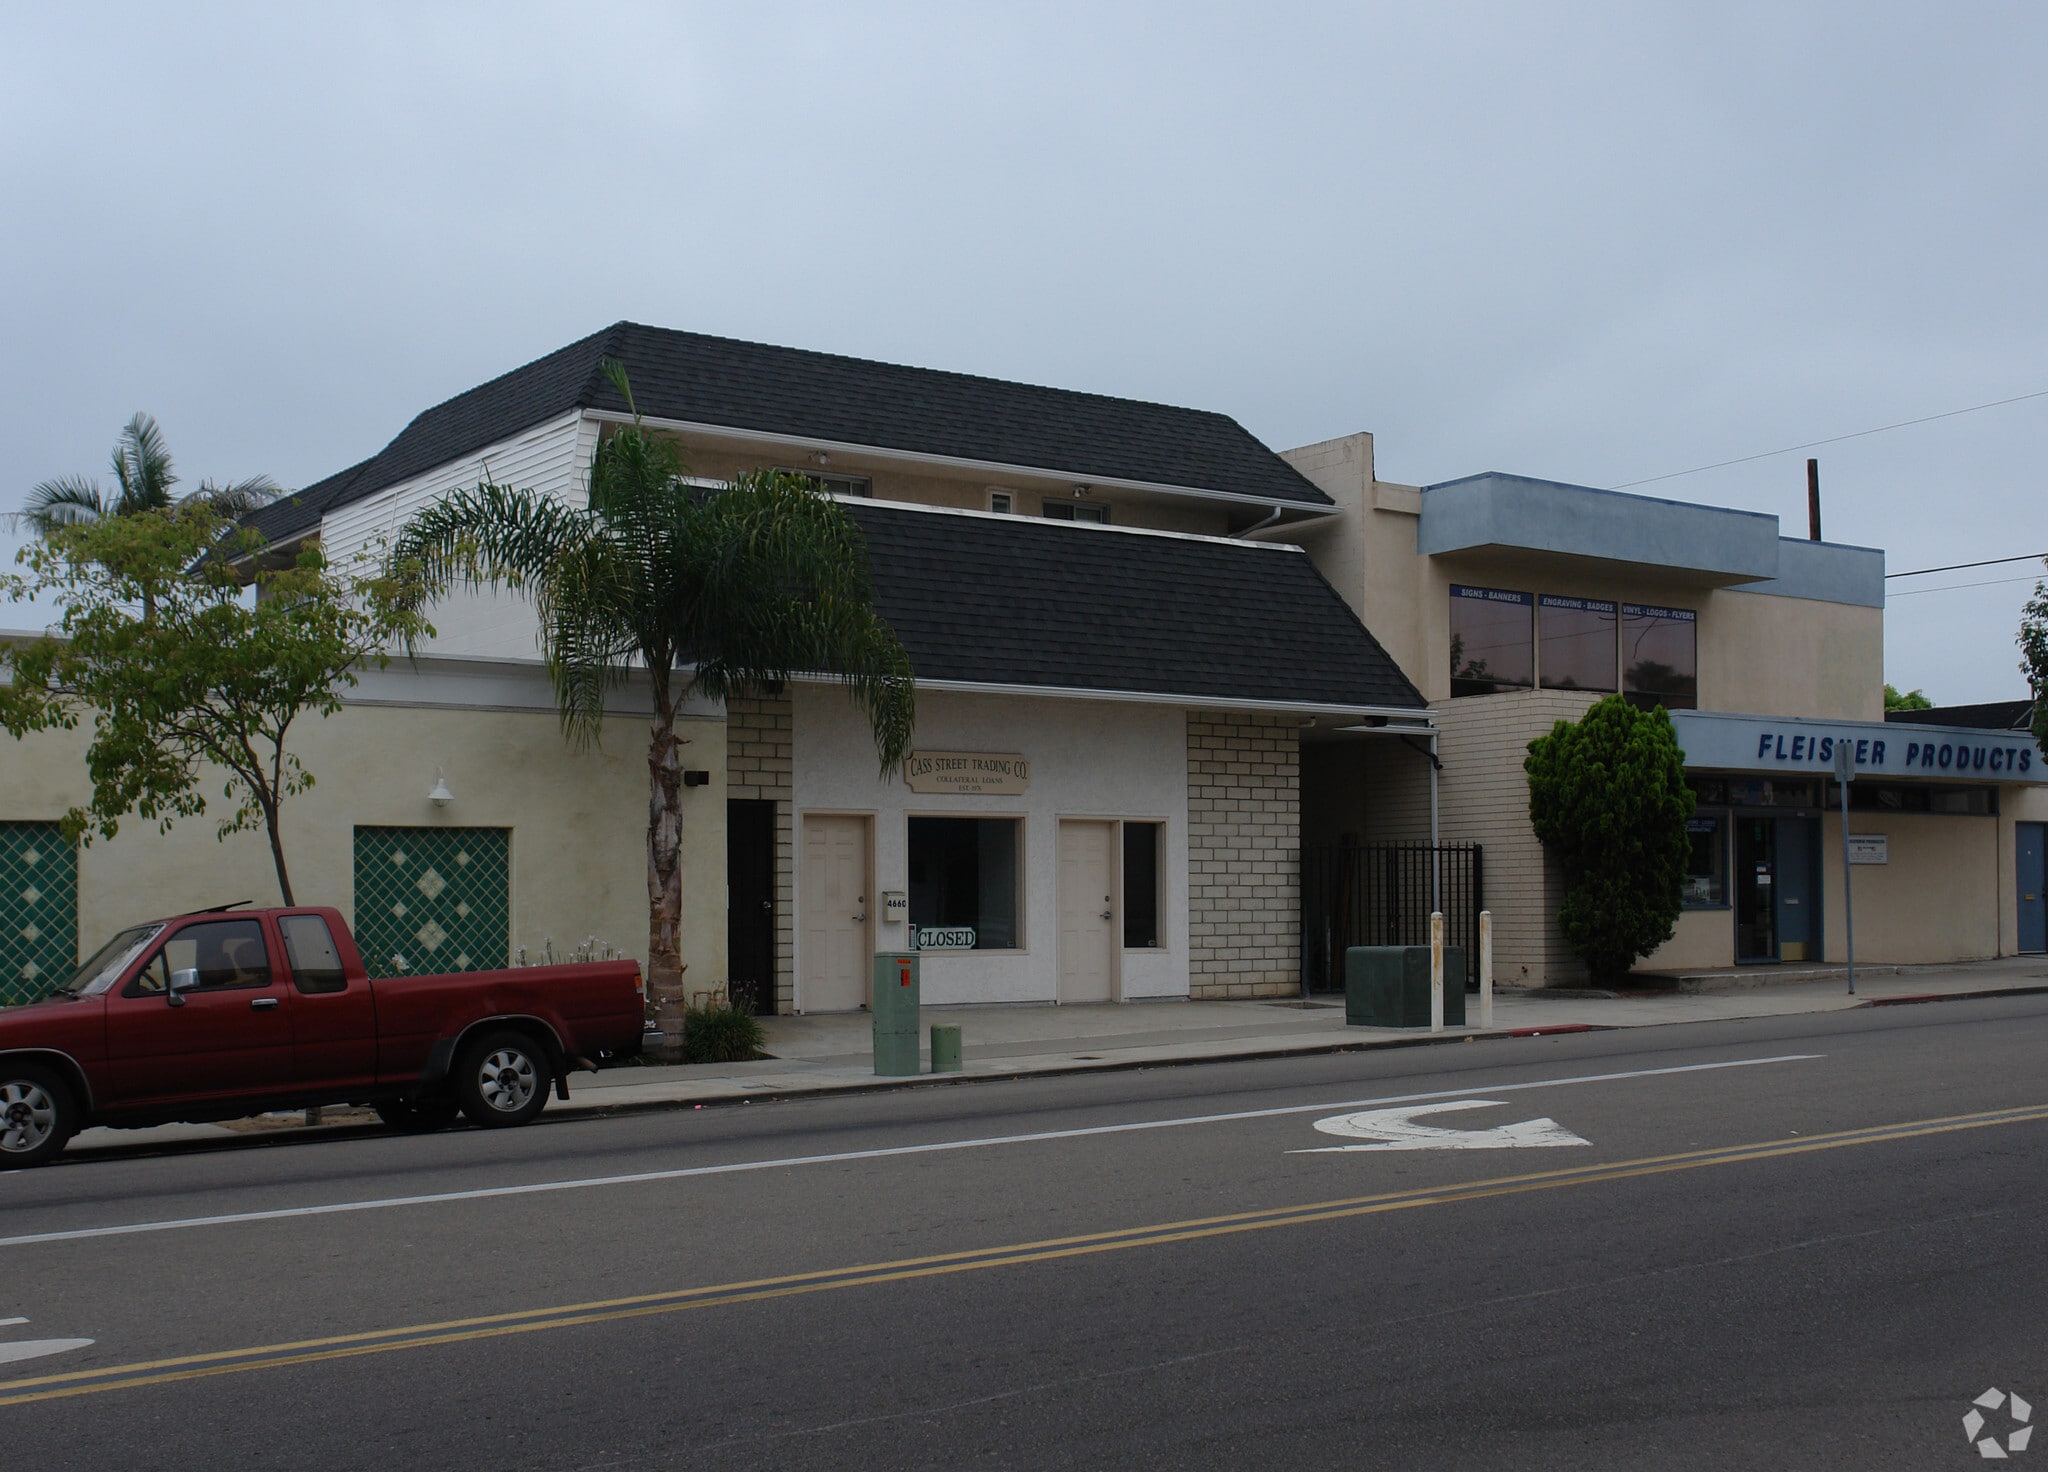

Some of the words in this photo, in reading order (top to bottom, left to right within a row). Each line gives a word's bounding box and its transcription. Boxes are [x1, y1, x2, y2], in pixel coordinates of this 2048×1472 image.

[1461, 588, 1483, 598] SIGNS
[1488, 591, 1521, 602] BANNERS
[1543, 597, 1582, 608] ENGRAVING
[1587, 602, 1613, 611] BADGES
[1623, 605, 1642, 614] VINYL
[1646, 608, 1667, 617] LOGOS
[1672, 611, 1695, 620] FLYERS
[1758, 734, 1886, 764] FLEISER
[1906, 742, 2032, 772] PRODUCTS
[910, 758, 932, 777] CASS
[935, 758, 968, 771] STREET
[972, 759, 1011, 775] TRADING
[1014, 760, 1028, 780] CO.
[982, 776, 1003, 784] LOANS
[887, 899, 907, 908] 4660
[918, 931, 975, 947] CLOSED
